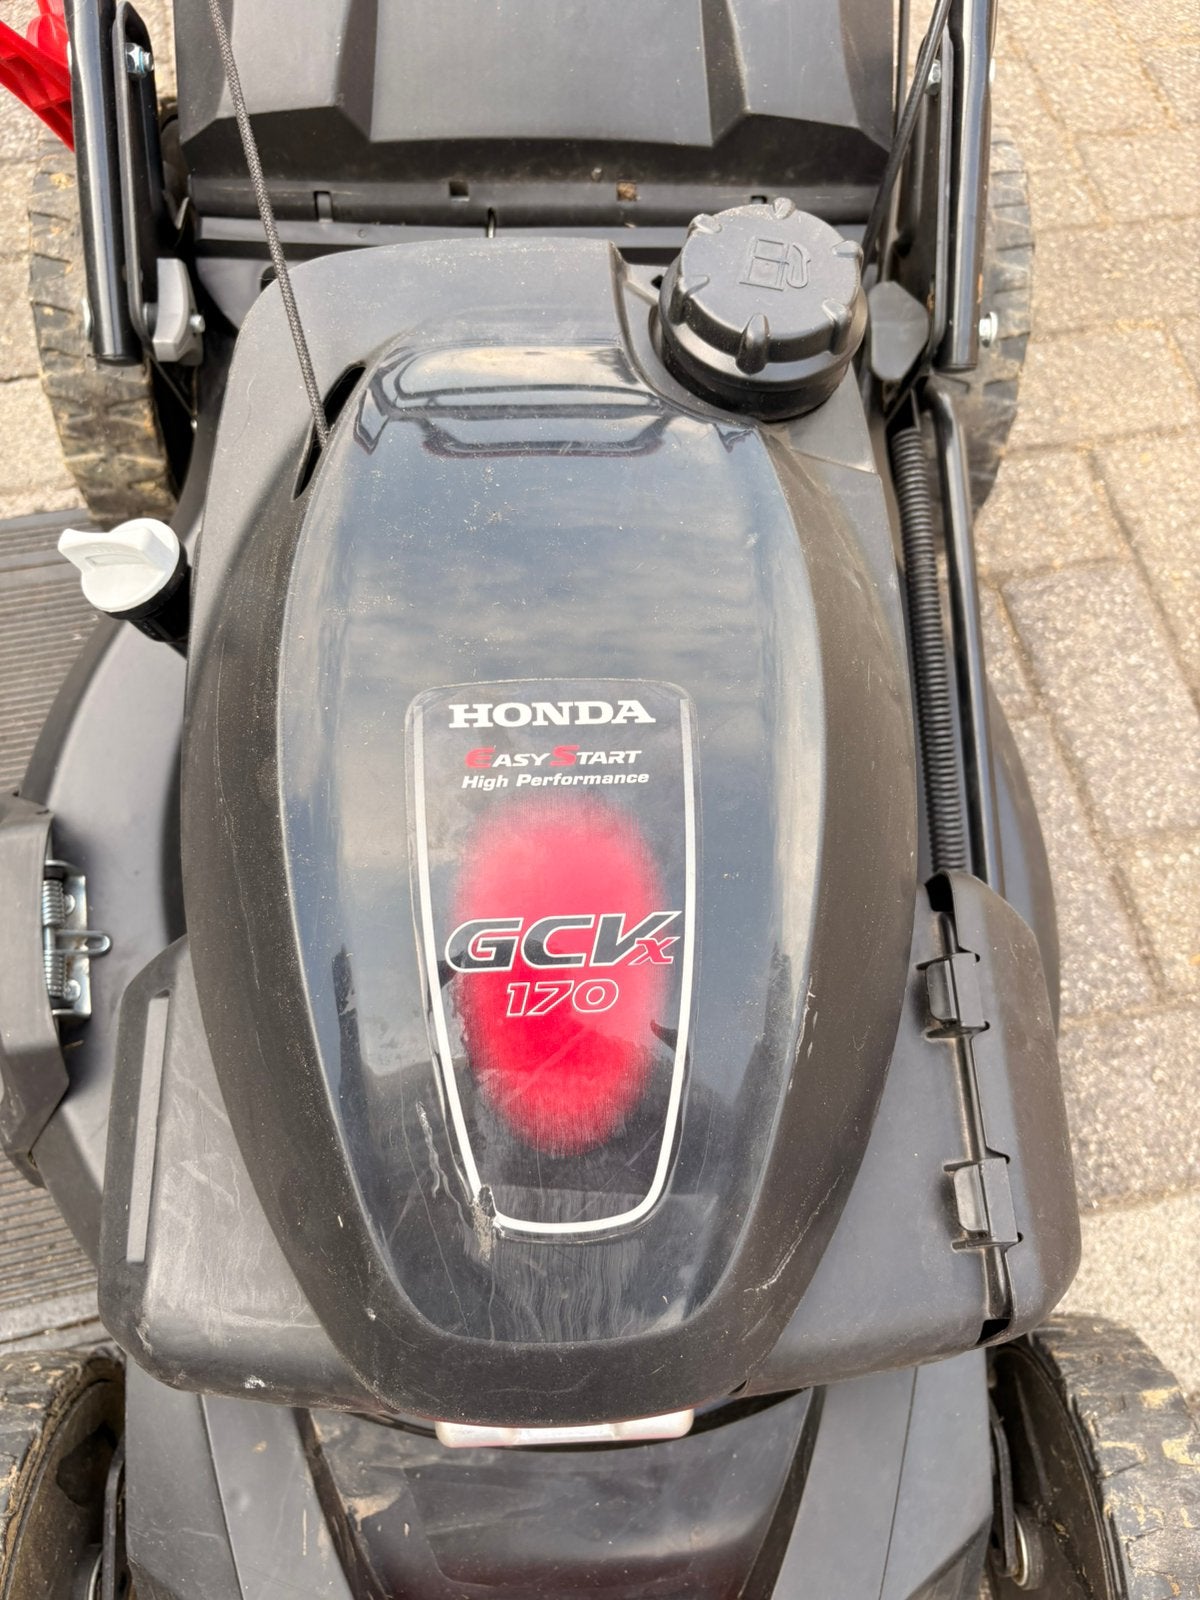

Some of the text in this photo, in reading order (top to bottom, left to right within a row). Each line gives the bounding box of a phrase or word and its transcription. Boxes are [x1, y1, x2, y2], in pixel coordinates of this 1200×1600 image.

[448, 700, 656, 728] HONDA
[461, 773, 650, 791] High Performance
[506, 979, 619, 1017] 170
